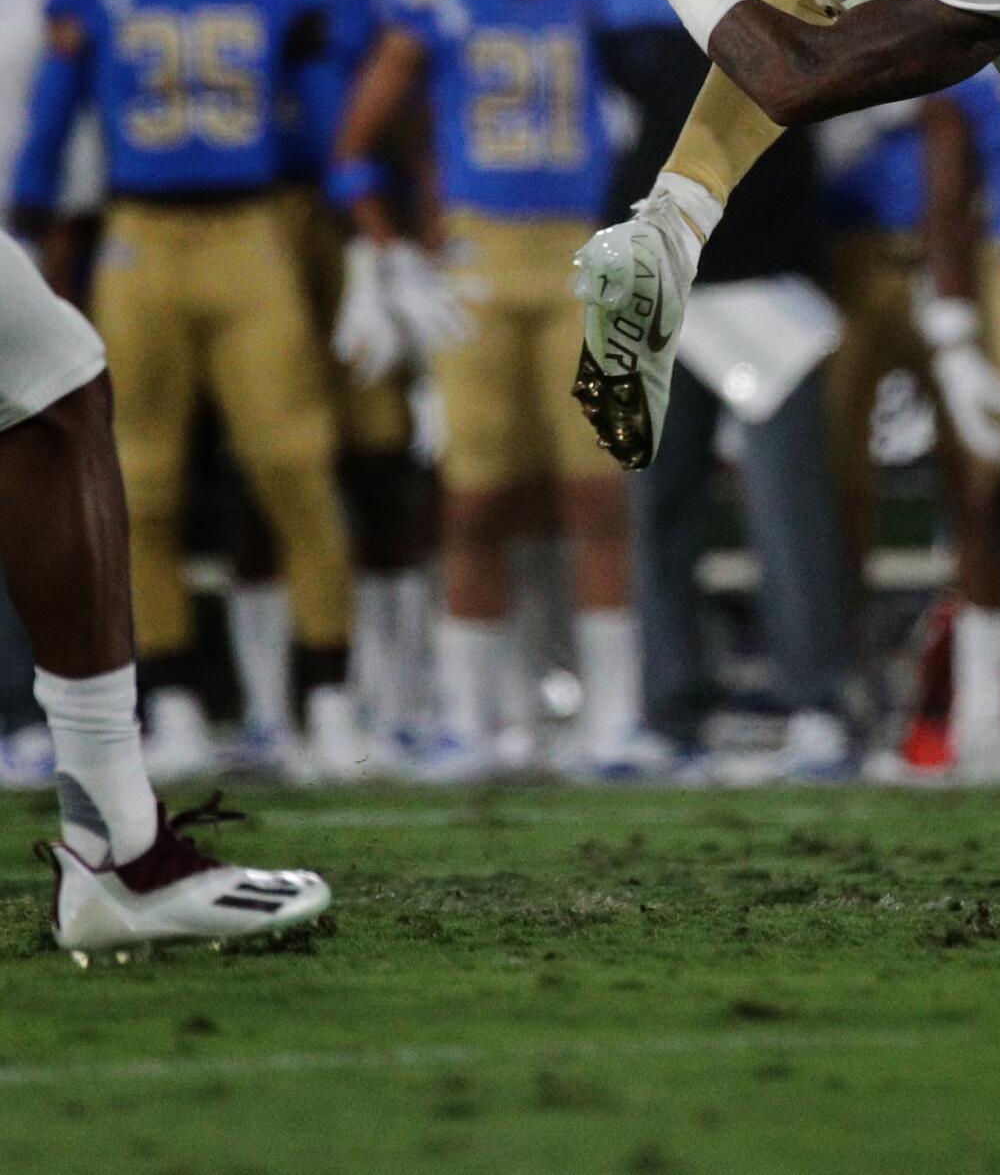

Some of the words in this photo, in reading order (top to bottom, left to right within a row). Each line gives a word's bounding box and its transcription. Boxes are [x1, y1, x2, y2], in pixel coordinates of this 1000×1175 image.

[117, 6, 265, 148] 35
[466, 29, 584, 167] 21
[604, 234, 655, 373] VAPOR
